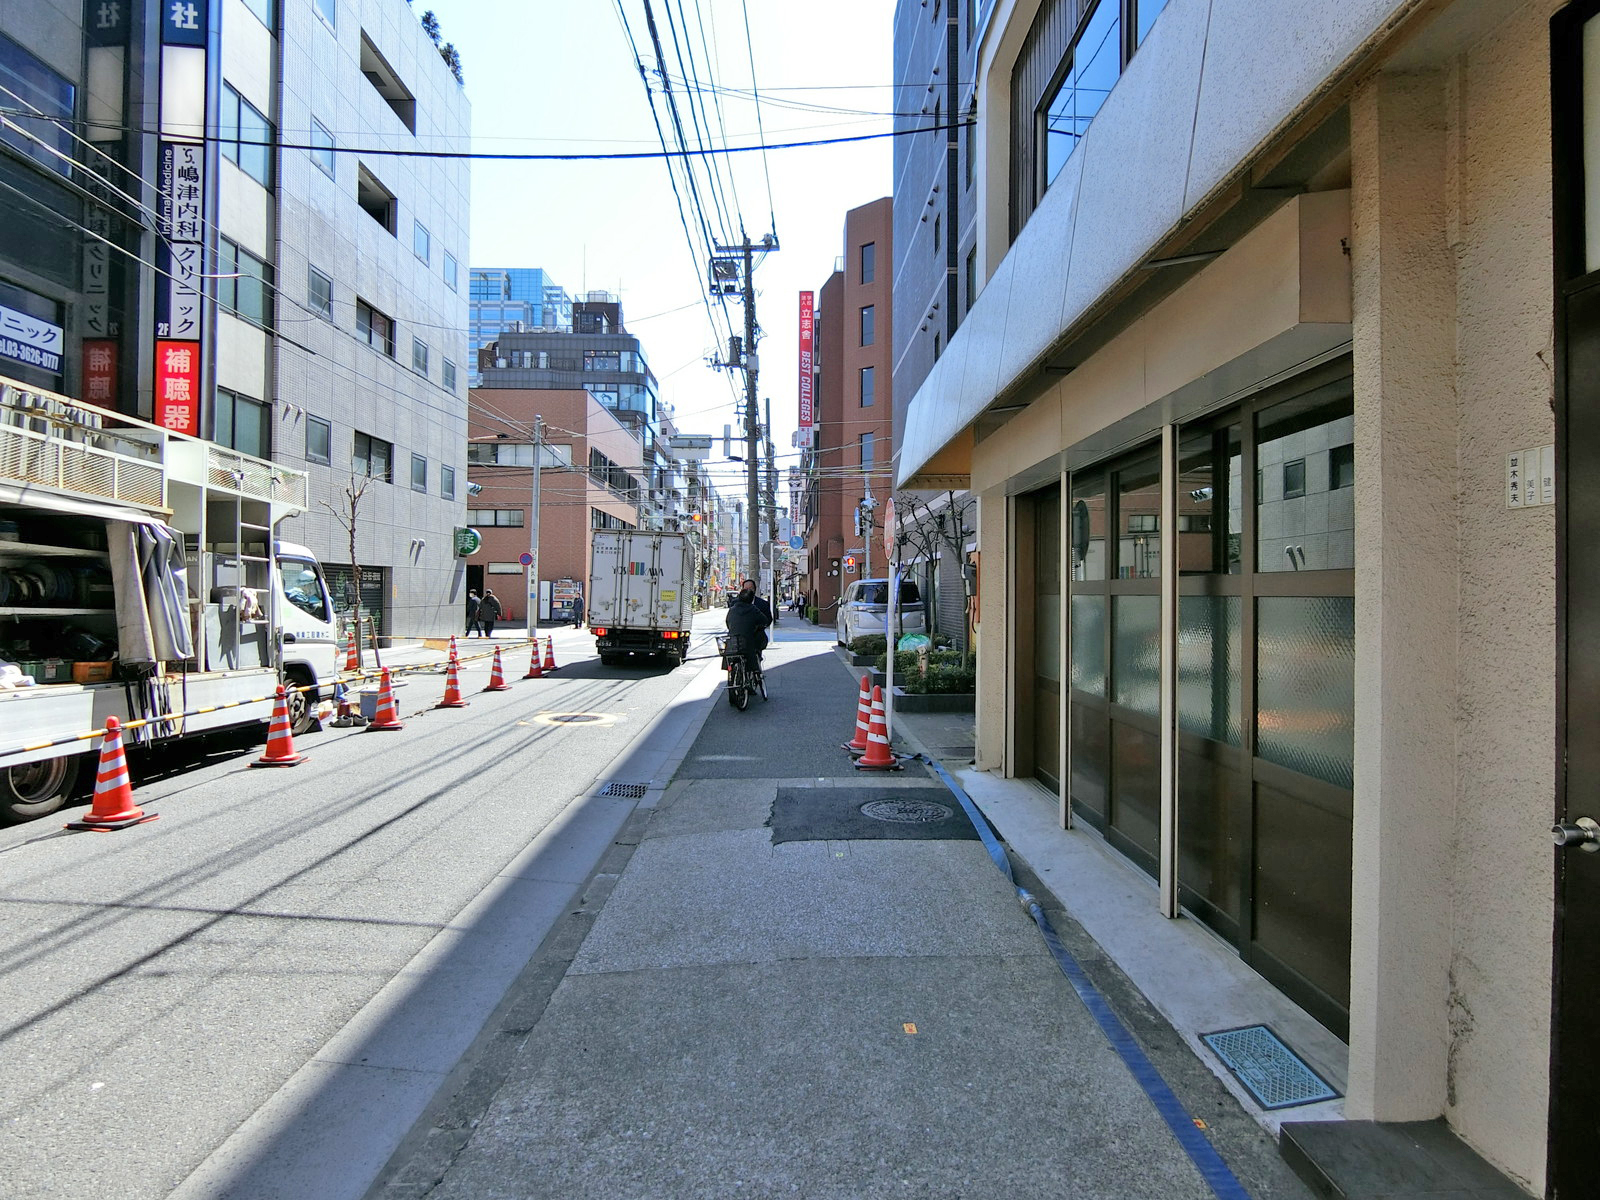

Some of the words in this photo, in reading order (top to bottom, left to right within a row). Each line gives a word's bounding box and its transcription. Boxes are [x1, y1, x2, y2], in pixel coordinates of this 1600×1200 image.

[171, 2, 199, 30] 社
[162, 149, 173, 195] Medicine
[162, 195, 173, 236] Internal
[157, 322, 169, 337] 2F
[801, 350, 811, 375] BEST
[164, 348, 192, 431] 補聴器
[801, 375, 811, 422] COLLEGES
[457, 532, 475, 550] 薬
